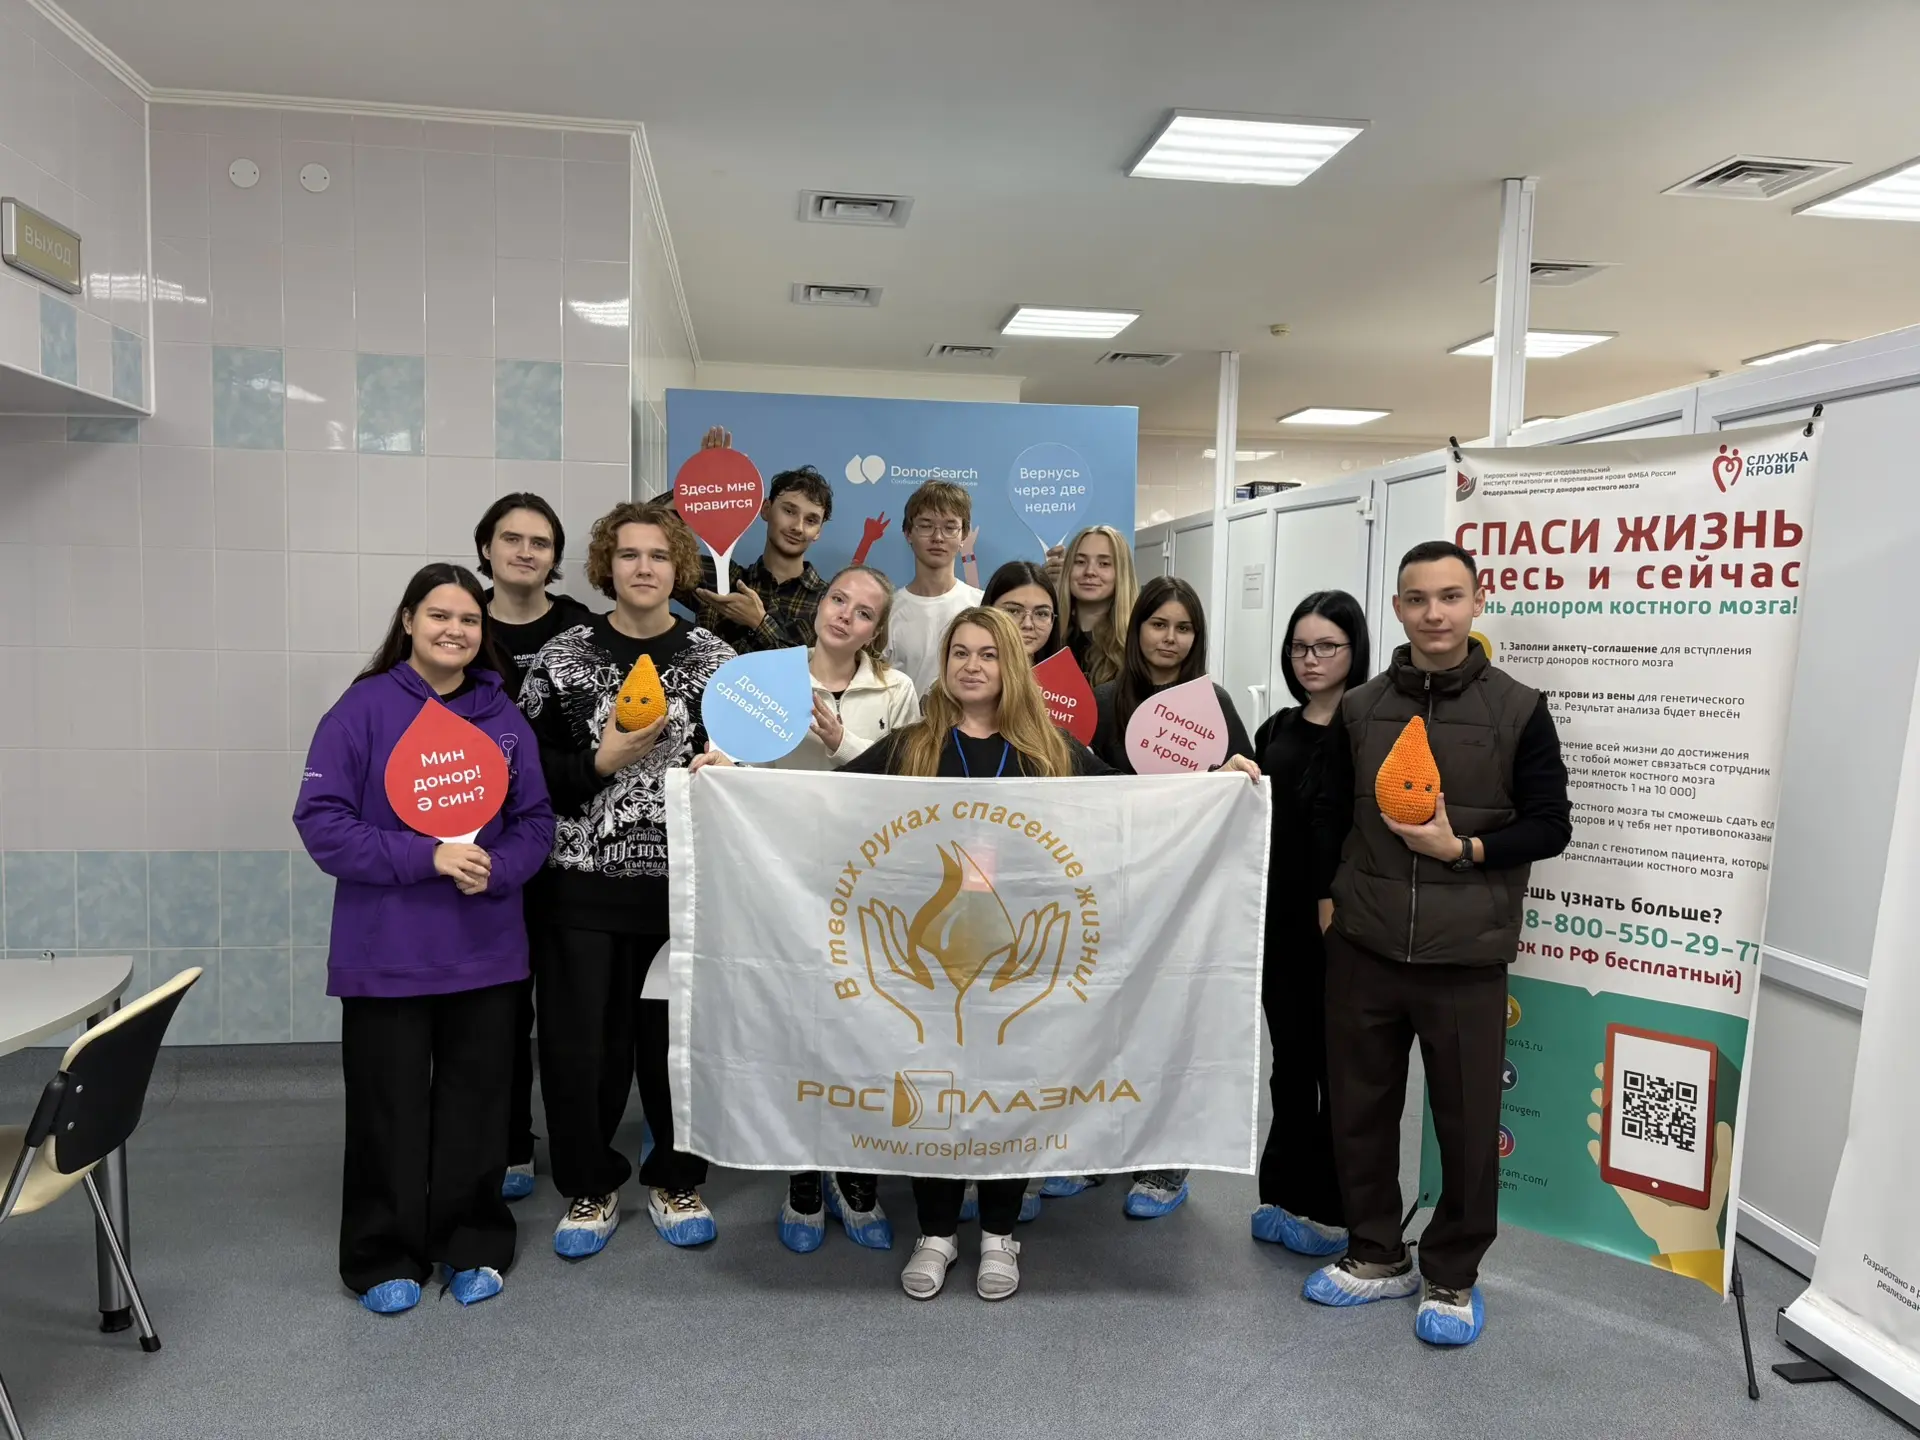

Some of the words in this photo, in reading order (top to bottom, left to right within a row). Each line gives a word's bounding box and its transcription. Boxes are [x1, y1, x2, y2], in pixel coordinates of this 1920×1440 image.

[24, 224, 72, 267] ВЫХОД
[1745, 463, 1795, 477] КРОВИ
[1746, 451, 1809, 466] СЛУЖБА
[891, 465, 978, 479] DonorSearch
[1020, 467, 1080, 482] Вернусь
[1627, 471, 1649, 479] ФМБА
[679, 480, 724, 497] Здесь
[726, 479, 757, 494] мне
[1014, 485, 1056, 498] через
[1060, 484, 1086, 498] две
[1482, 488, 1528, 497] Федеральный
[1529, 487, 1555, 496] регистр
[1556, 486, 1585, 494] доноров
[1586, 484, 1618, 492] костного
[1618, 482, 1640, 490] мозга
[684, 495, 754, 513] нравится
[1025, 500, 1076, 514] недели
[1455, 518, 1600, 557] СПАСИ
[1613, 509, 1804, 553] ЖИЗНЬ
[1477, 566, 1564, 594] десь
[1588, 566, 1610, 590] и
[1636, 555, 1801, 590] сейчас
[1510, 600, 1603, 619] донором
[1610, 598, 1711, 615] костного
[1718, 595, 1799, 615] мозга!
[1499, 642, 1507, 651] 1.
[1509, 642, 1550, 652] Заполни
[1552, 643, 1658, 654] анкету-соглашение
[1660, 646, 1681, 656] для
[1684, 646, 1752, 658] вступления
[1499, 655, 1505, 663] в
[1507, 655, 1544, 666] Регистр
[1546, 657, 1589, 668] доноров
[1591, 658, 1639, 667] костного
[1641, 658, 1674, 668] мозга
[735, 675, 789, 723] Доноры,
[1559, 690, 1590, 700] крови
[1592, 691, 1605, 701] из
[1607, 692, 1635, 702] вены
[1637, 693, 1657, 703] для
[1660, 693, 1745, 706] генетического
[716, 682, 794, 742] сдавайтесь!
[1153, 703, 1216, 741] Помощь
[1564, 702, 1614, 714] Результат
[1616, 706, 1660, 716] анализа
[1663, 706, 1696, 719] будет
[1699, 708, 1741, 720] внесён
[1154, 726, 1168, 739] у
[1170, 733, 1198, 751] нас
[1559, 741, 1593, 750] ечение
[1595, 742, 1620, 752] всей
[1622, 745, 1658, 755] жизни
[1660, 747, 1675, 756] до
[1677, 748, 1750, 760] достижения
[420, 749, 465, 767] Мин
[1140, 737, 1149, 749] в
[1152, 744, 1200, 771] крови
[1560, 753, 1570, 761] ет
[1572, 754, 1578, 762] с
[1580, 754, 1611, 765] тобой
[1613, 758, 1649, 768] может
[1651, 759, 1706, 772] связаться
[1709, 763, 1771, 776] сотрудник
[413, 765, 482, 794] донор!
[1565, 780, 1628, 792] вероятность
[1631, 783, 1636, 792] 1
[1638, 785, 1651, 794] на
[1655, 785, 1666, 795] 10
[1566, 767, 1589, 776] дачи
[1591, 768, 1627, 779] клеток
[1629, 772, 1679, 784] костного
[1682, 775, 1715, 786] мозга
[417, 796, 433, 813] Ә
[437, 786, 486, 808] син?
[1569, 814, 1606, 826] здоров
[1608, 819, 1615, 827] и
[1617, 819, 1624, 829] у
[1626, 818, 1651, 830] тебя
[1653, 822, 1672, 832] нет
[1675, 823, 1772, 843] противопоказани
[1616, 806, 1648, 817] мозга
[1651, 809, 1665, 818] ты
[1668, 811, 1723, 824] сможешь
[1726, 816, 1758, 827] сдать
[1760, 820, 1775, 830] есл
[859, 803, 941, 867] руках
[952, 800, 1084, 879] спасение
[1560, 852, 1644, 869] трансплантации
[1646, 862, 1697, 875] костного
[1700, 867, 1734, 879] мозга
[1602, 843, 1608, 852] с
[1610, 844, 1668, 858] генотипом
[1671, 851, 1728, 866] пациента,
[1731, 857, 1769, 871] которы
[828, 860, 863, 966] твоих
[1561, 890, 1626, 911] узнать
[1631, 897, 1723, 924] больше?
[1066, 884, 1101, 1004] жизни!
[1525, 908, 1760, 966] 8-800-550-29-77
[1541, 944, 1564, 959] по
[1569, 945, 1600, 965] РФ
[834, 977, 861, 1000] В
[1506, 1038, 1543, 1052] or43.ru
[797, 1079, 886, 1112] РОС
[937, 1079, 1142, 1114] ПЛАЗМА
[1502, 1100, 1541, 1118] irovgem
[851, 1131, 1068, 1160] www.rosplasma.ru
[1862, 1253, 1909, 1290] Разработано
[1909, 1285, 1916, 1294] в
